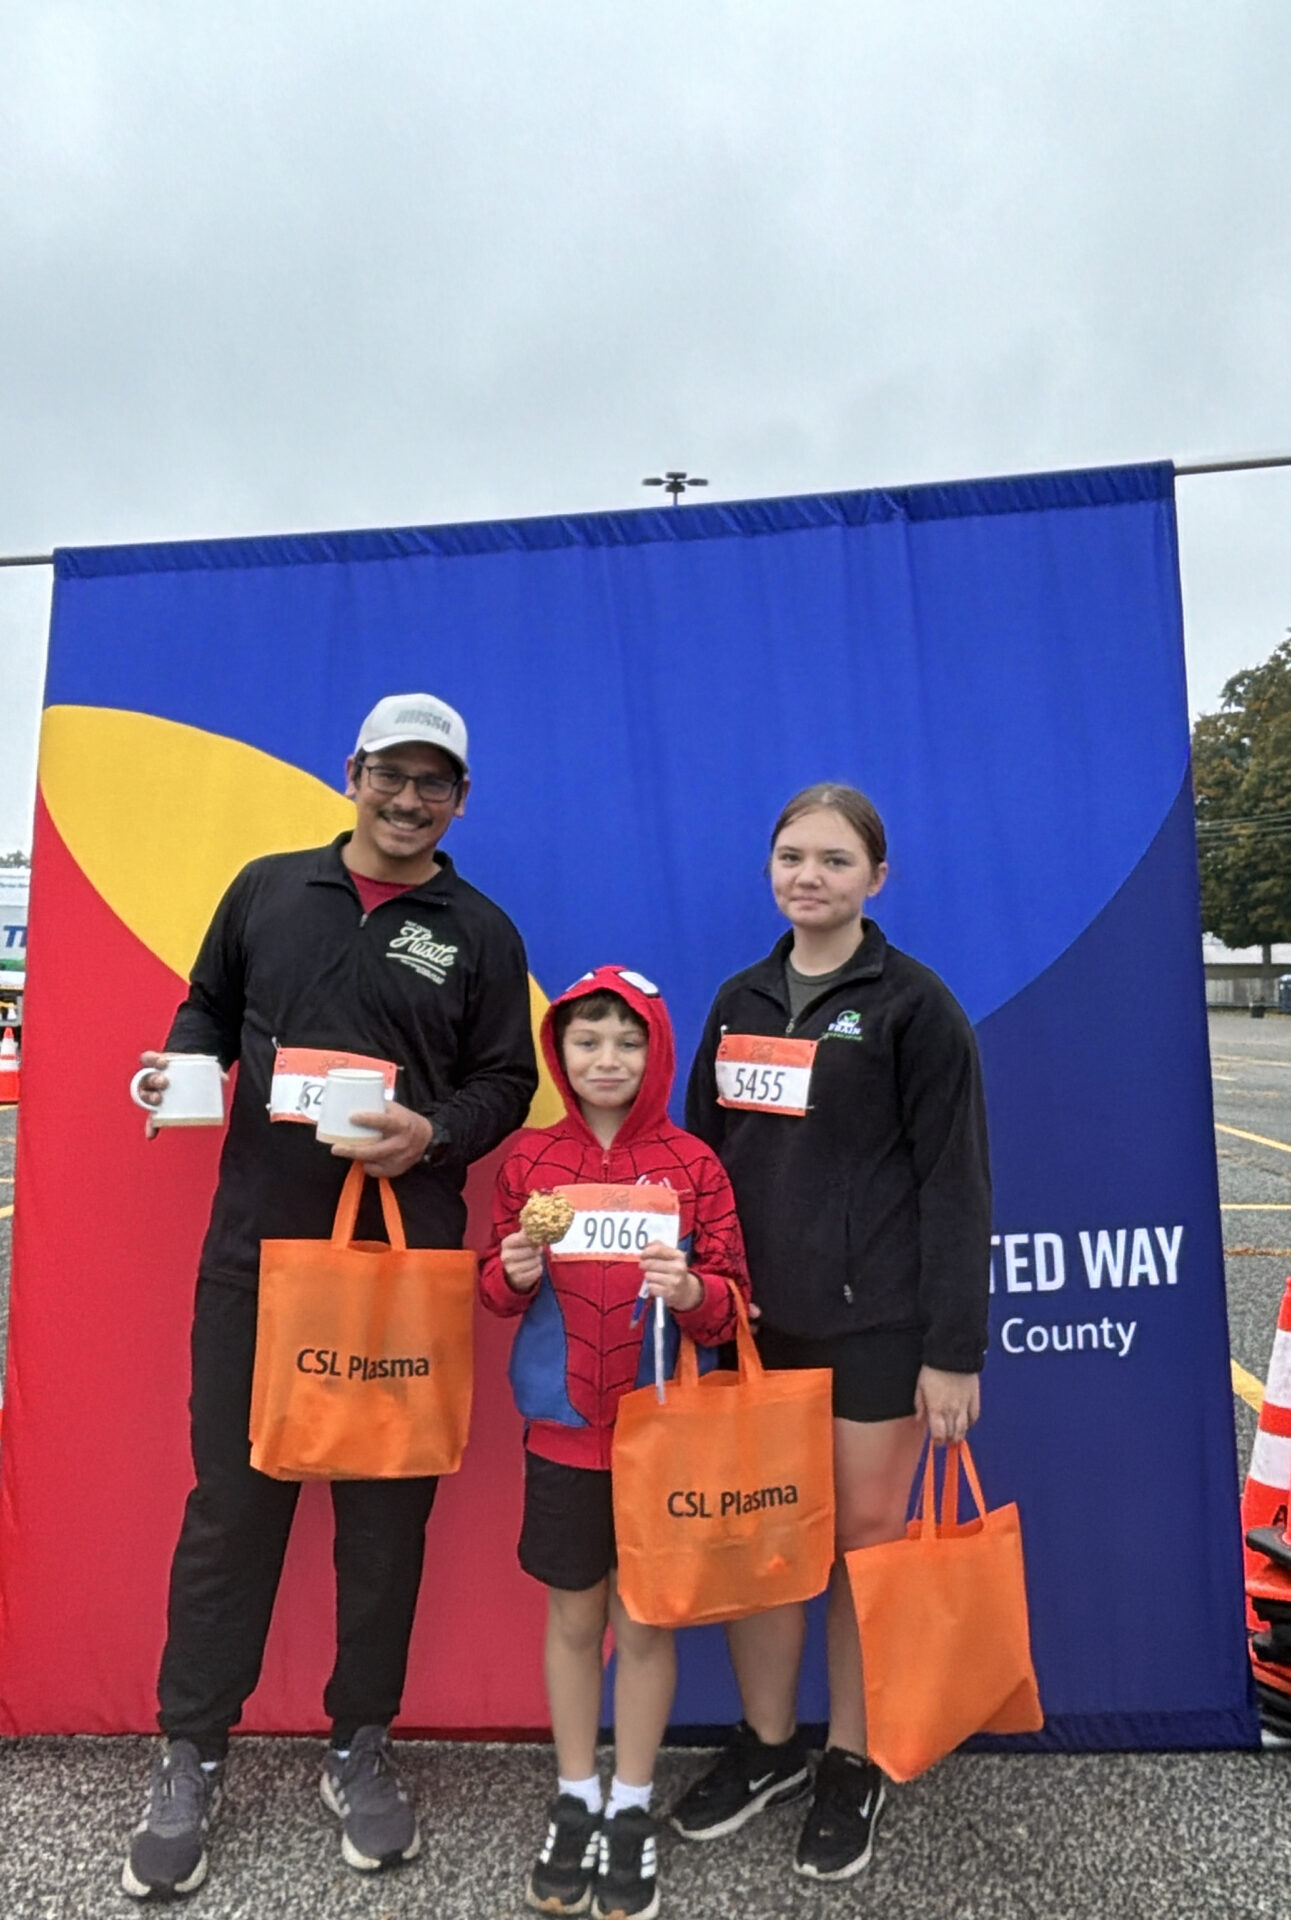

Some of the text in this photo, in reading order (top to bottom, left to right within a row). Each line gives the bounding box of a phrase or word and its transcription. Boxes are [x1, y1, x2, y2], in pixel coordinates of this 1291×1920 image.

[389, 926, 458, 967] Hustle
[733, 1068, 786, 1102] 5455
[584, 1217, 648, 1250] 9066
[1078, 1225, 1184, 1289] WAY
[1001, 1316, 1137, 1357] County
[296, 1348, 429, 1381] CSL Plasma
[667, 1484, 798, 1518] CSL Plasma
